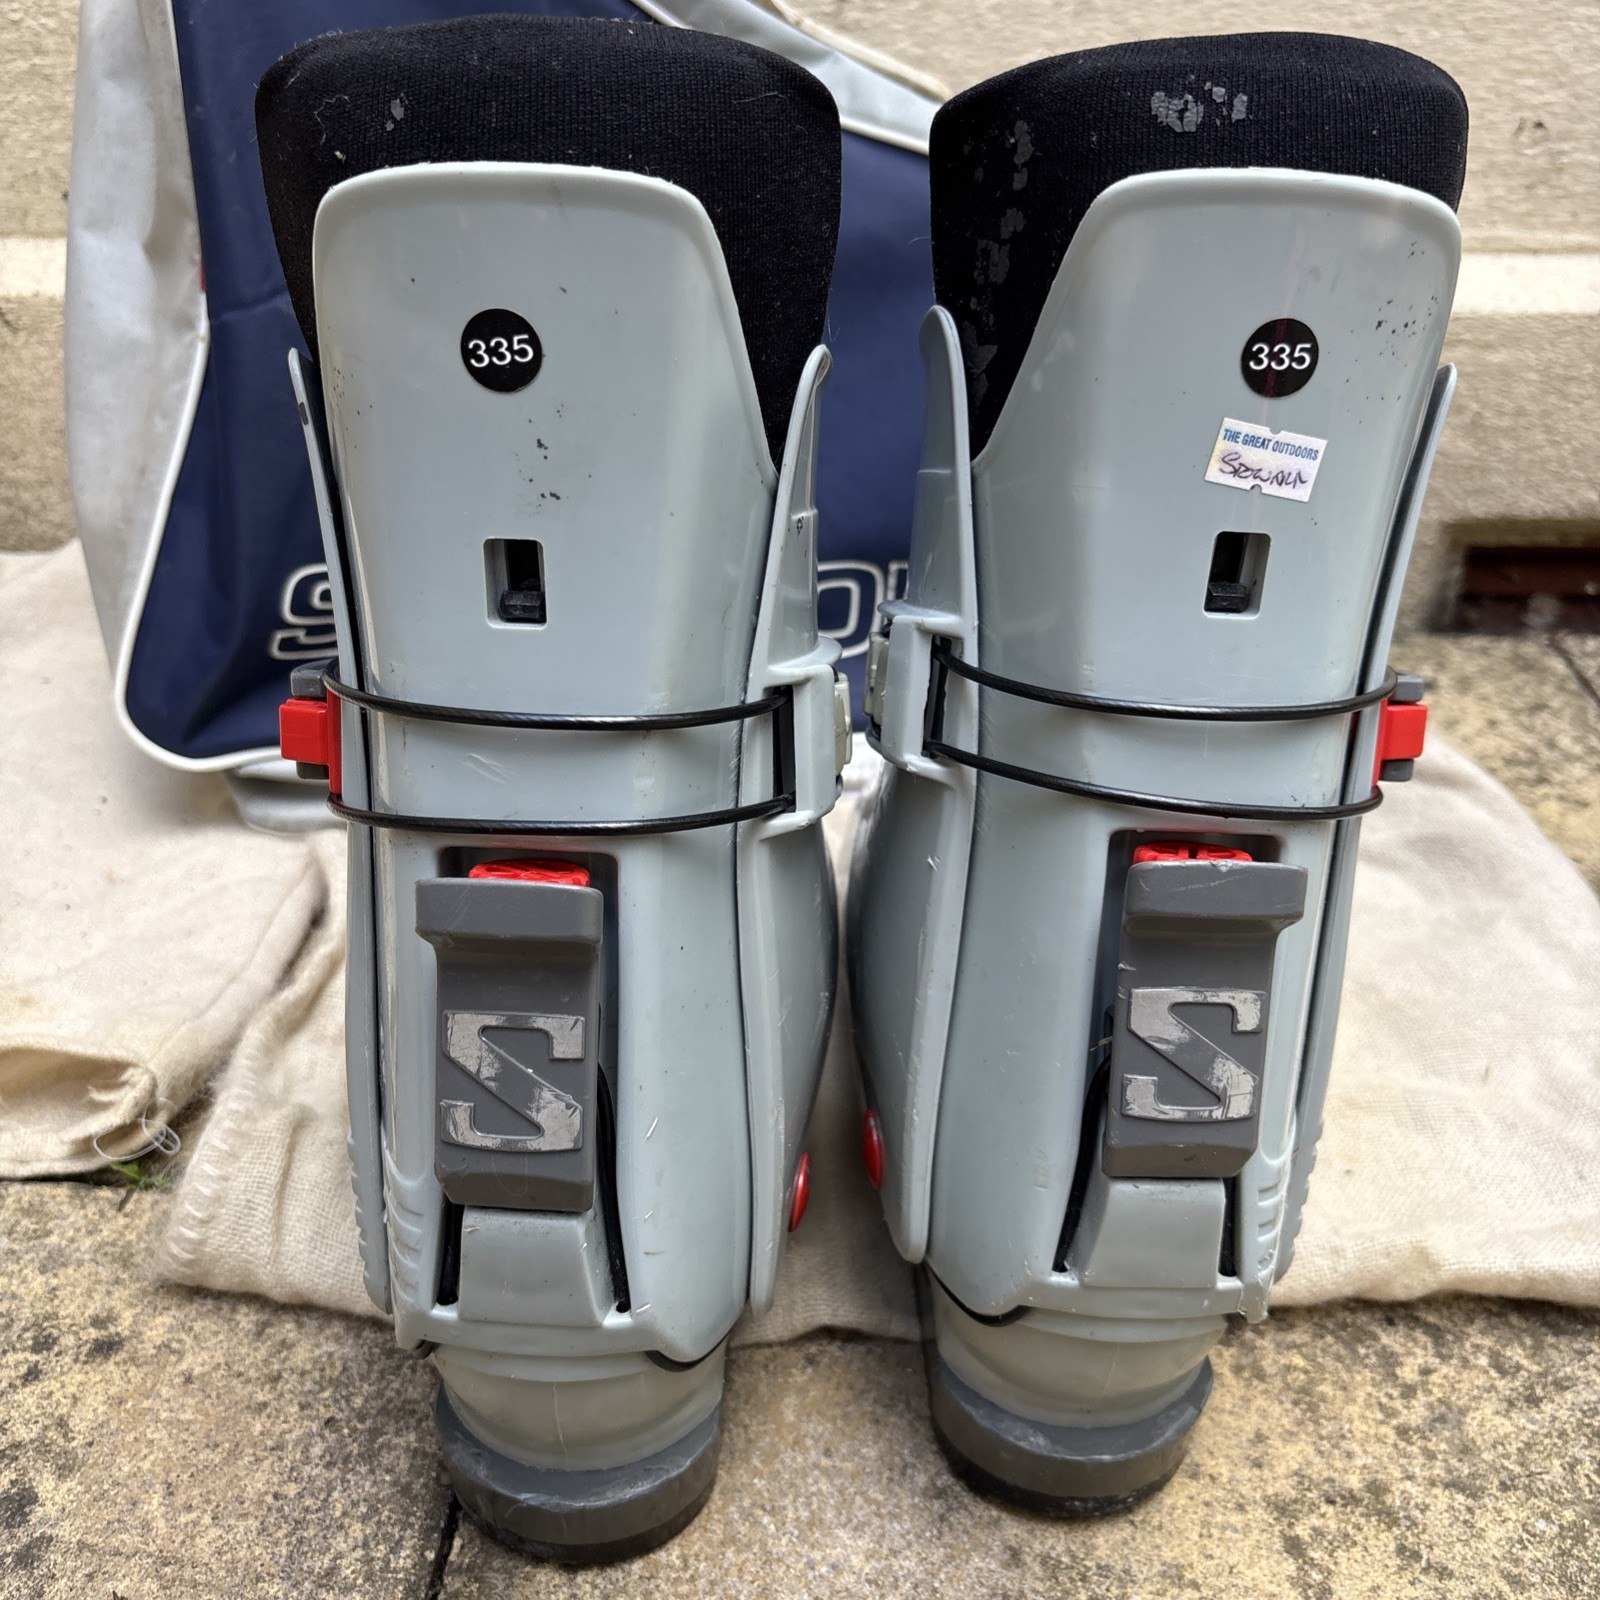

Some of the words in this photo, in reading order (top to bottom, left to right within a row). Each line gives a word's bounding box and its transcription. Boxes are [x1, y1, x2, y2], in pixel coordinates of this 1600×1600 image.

[468, 334, 534, 368] 335
[1249, 343, 1312, 370] 335
[1222, 428, 1242, 443] THE
[1241, 433, 1272, 450] GREAT
[1271, 440, 1319, 461] OUTDOORS
